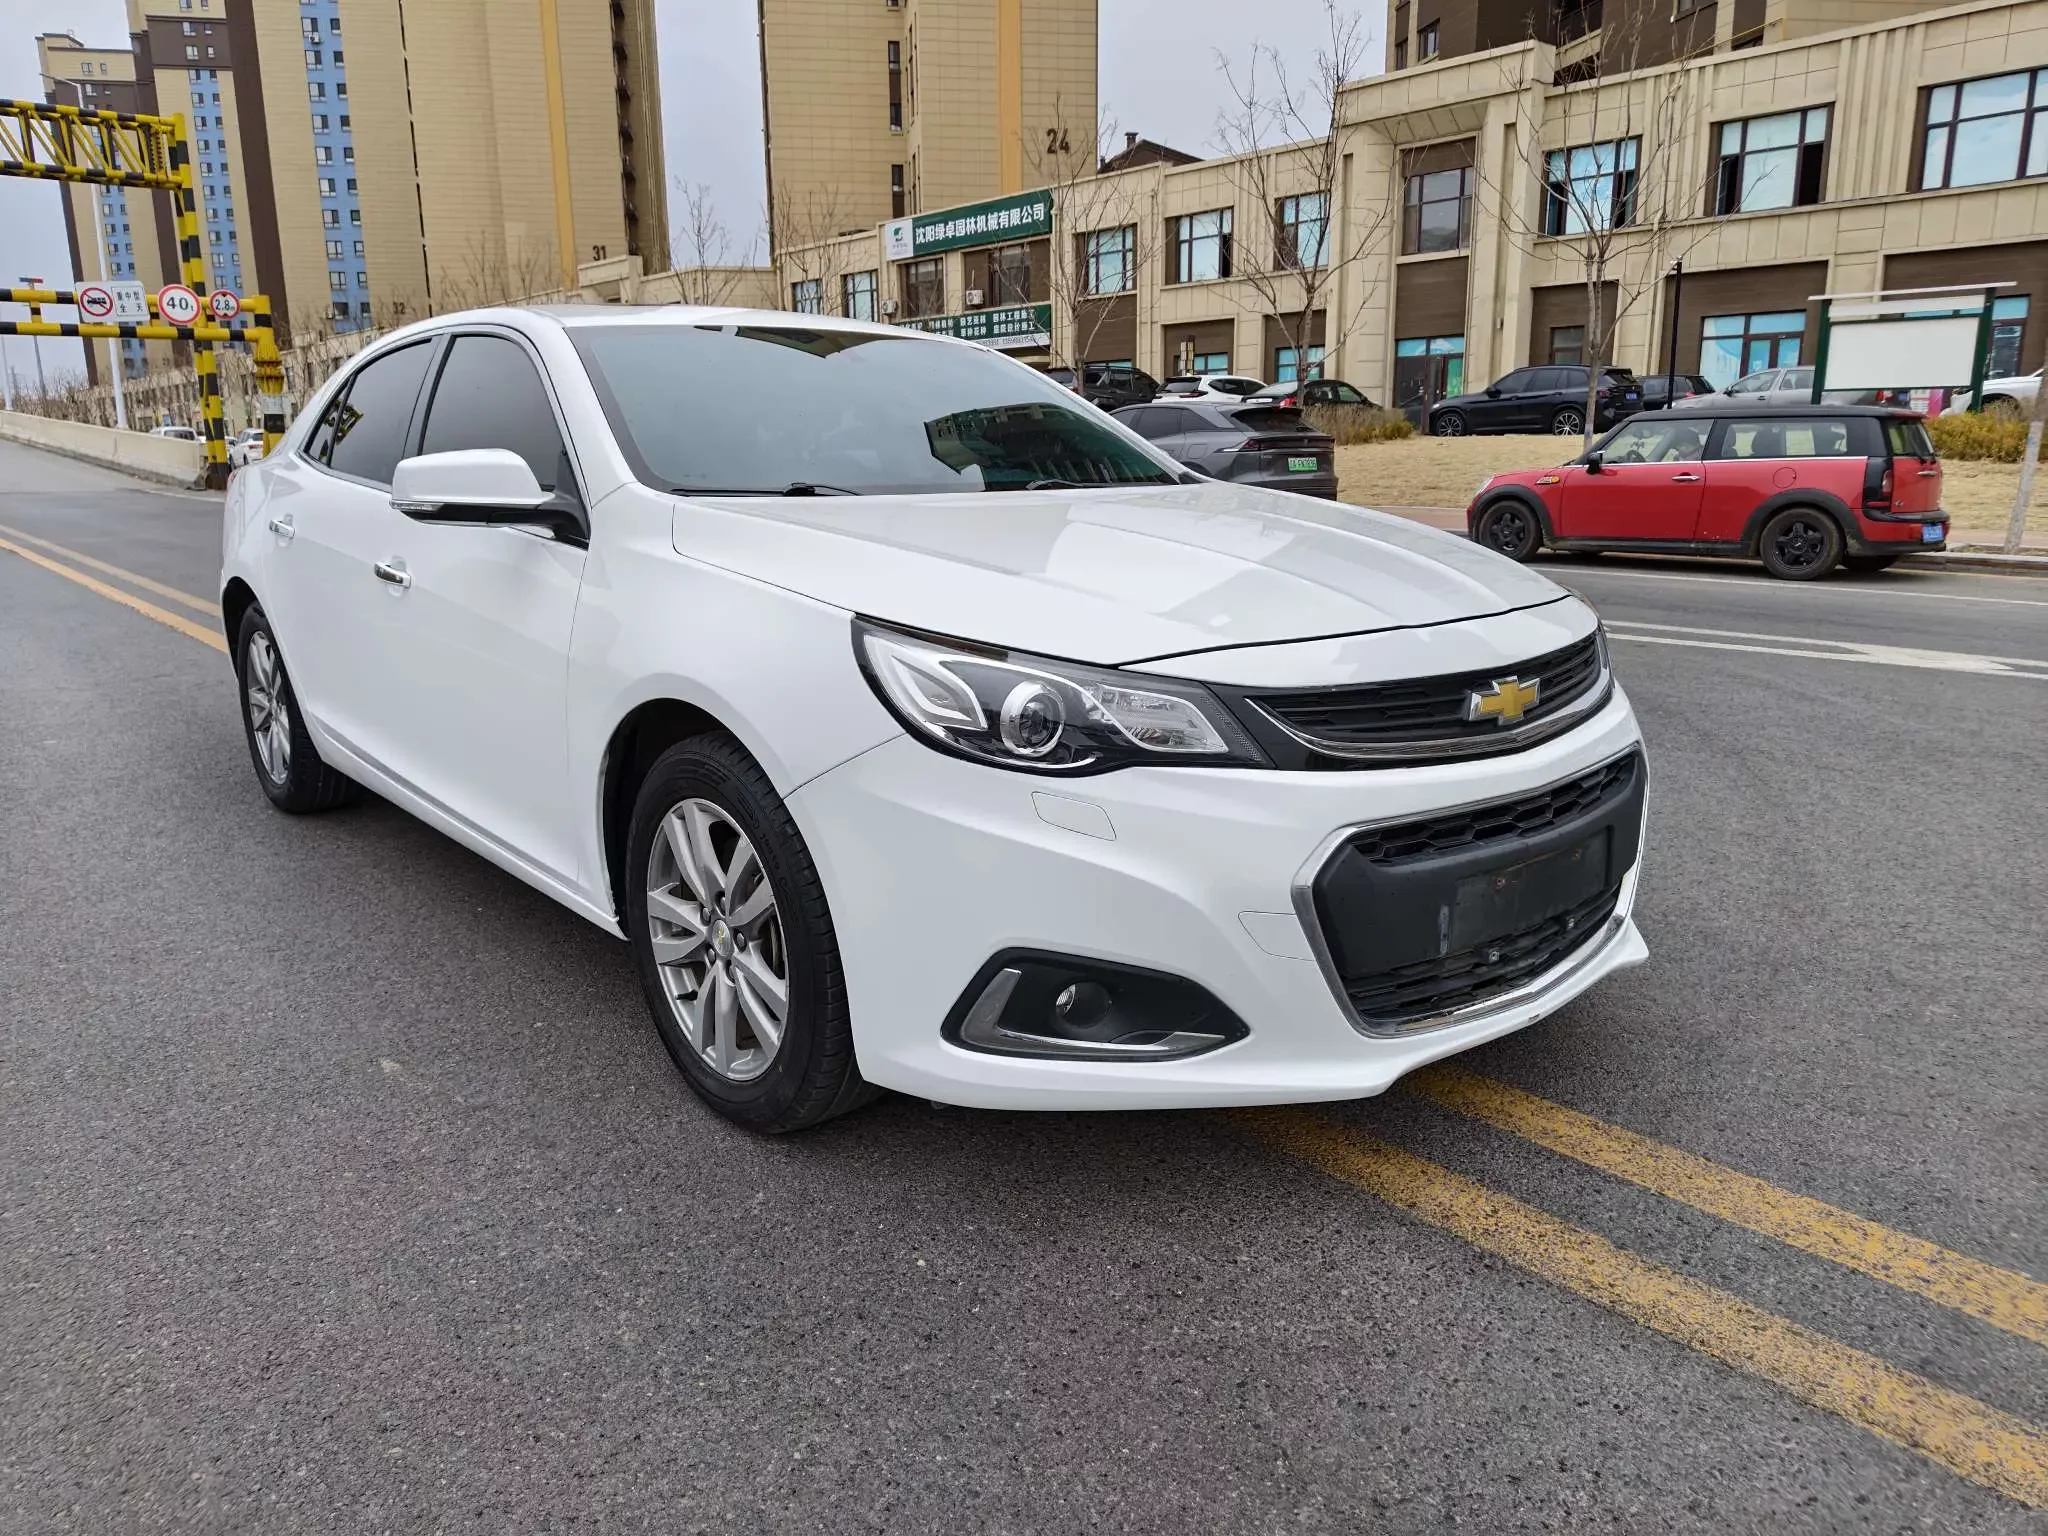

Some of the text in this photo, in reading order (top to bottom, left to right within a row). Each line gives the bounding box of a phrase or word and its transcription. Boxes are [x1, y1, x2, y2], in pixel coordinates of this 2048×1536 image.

[1047, 128, 1069, 154] 24
[915, 202, 1045, 245] 沈阳绿卓园林机械有限公司
[592, 245, 606, 261] 31
[116, 291, 140, 301] 重中型
